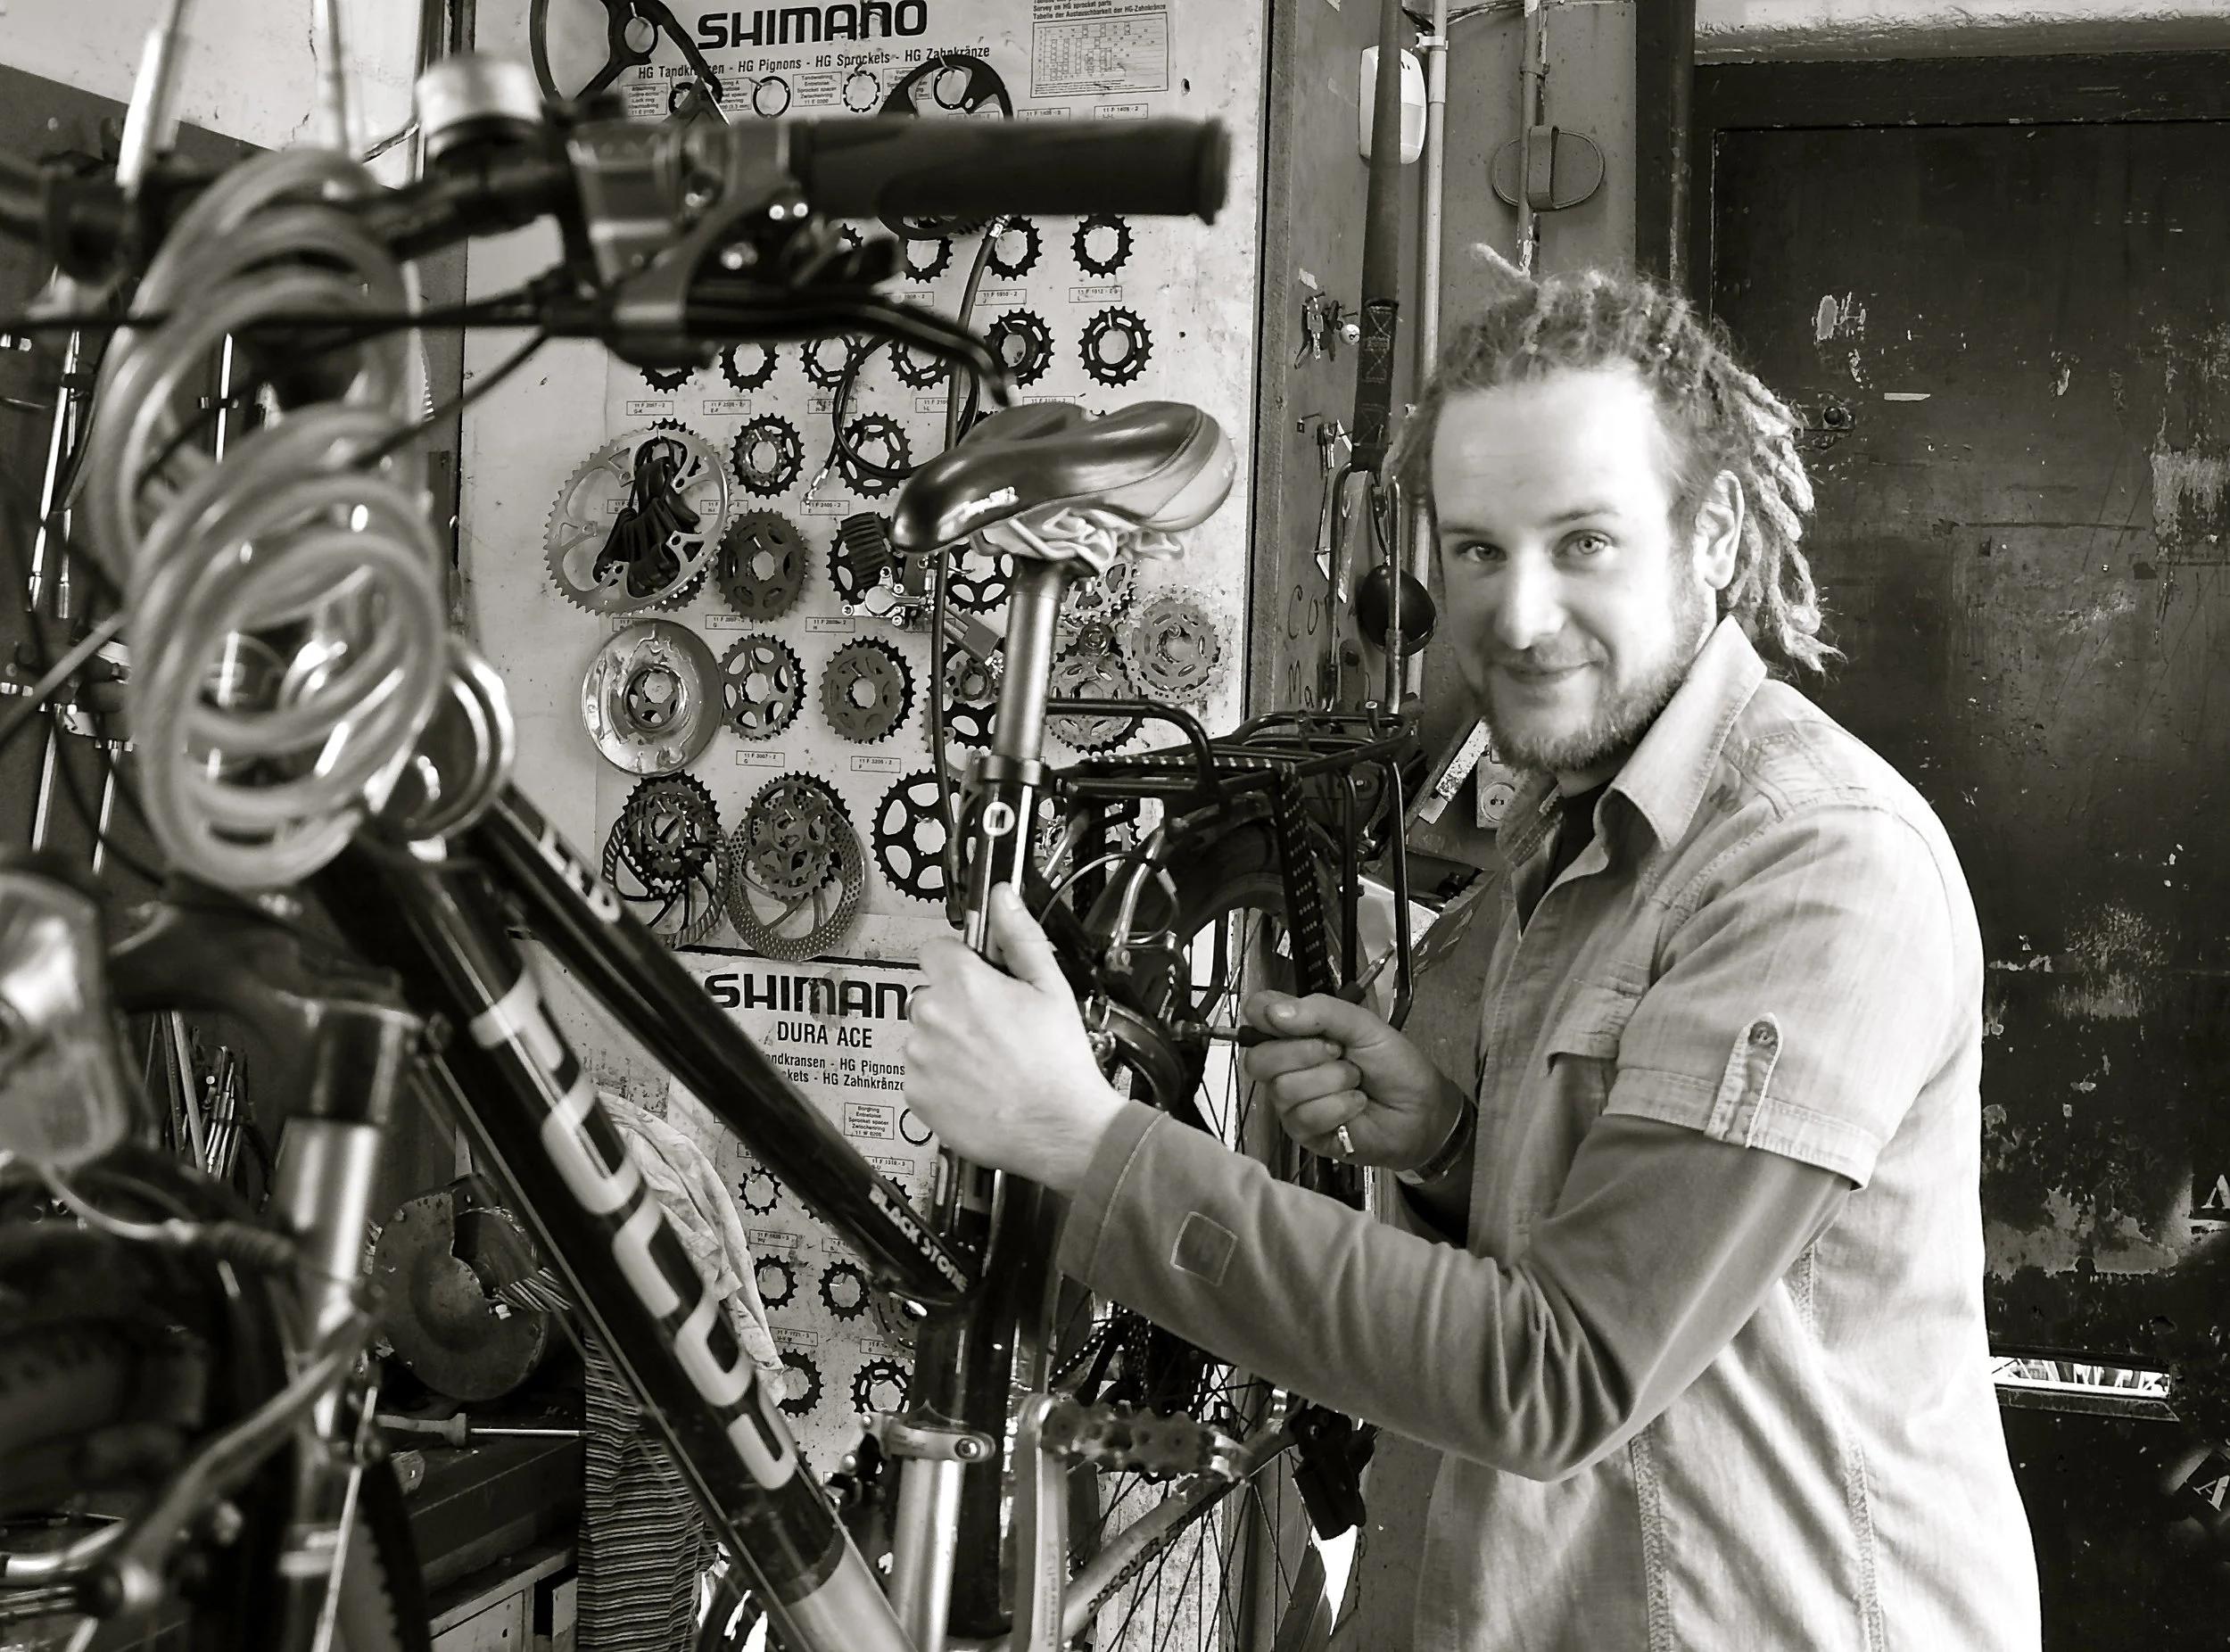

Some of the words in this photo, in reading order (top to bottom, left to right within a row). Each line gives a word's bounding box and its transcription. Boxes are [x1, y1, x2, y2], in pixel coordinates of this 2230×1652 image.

[698, 0, 927, 50] SHIMANO
[639, 66, 655, 79] HG
[738, 60, 754, 73] HG
[758, 59, 802, 73] Pignons
[815, 54, 832, 68] HG
[837, 52, 891, 69] Sprockets
[904, 48, 921, 62] HG
[705, 973, 929, 1020] SHIMAN
[777, 1020, 830, 1045] DURA
[836, 1026, 873, 1048] ACE
[765, 1053, 826, 1069] ndkransen
[839, 1058, 856, 1071] HG
[862, 1060, 905, 1076] Pignons
[822, 1071, 838, 1086] HG
[1087, 1537, 1159, 1614] DISCOVER
